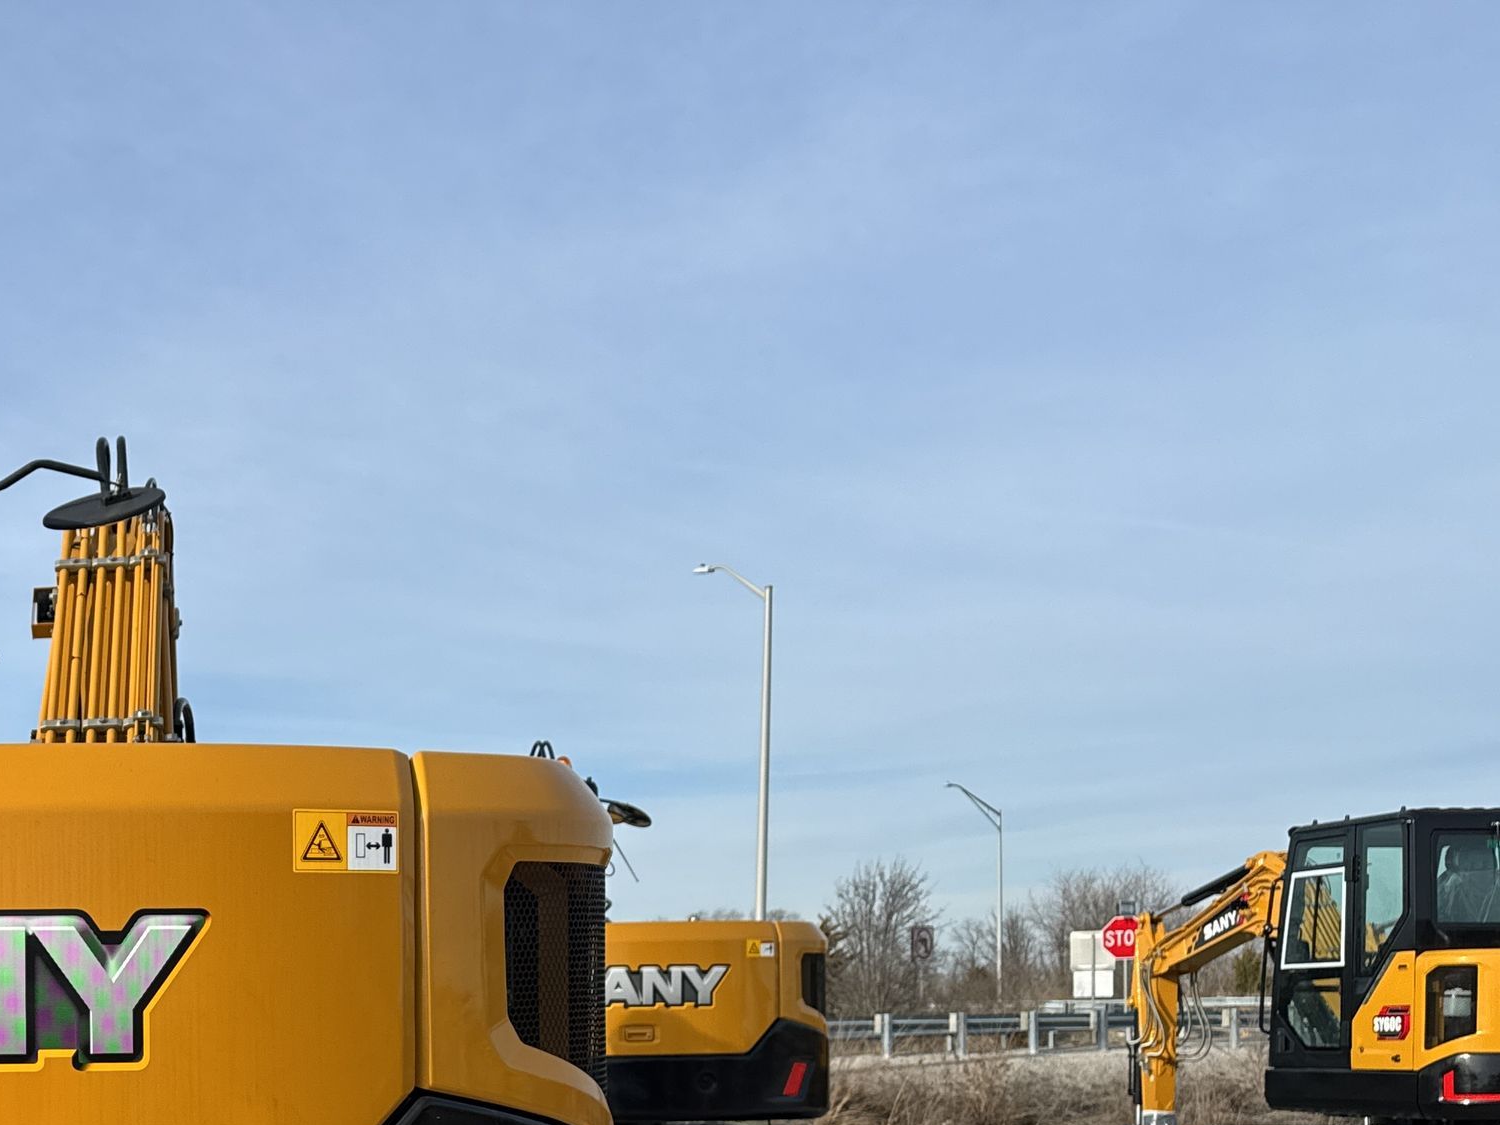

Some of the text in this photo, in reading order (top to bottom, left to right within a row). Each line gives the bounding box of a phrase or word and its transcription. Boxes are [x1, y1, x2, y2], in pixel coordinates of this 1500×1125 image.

[360, 815, 395, 824] WARNING
[1105, 928, 1137, 948] STO
[1203, 910, 1237, 941] SANY
[605, 964, 729, 1008] ANY
